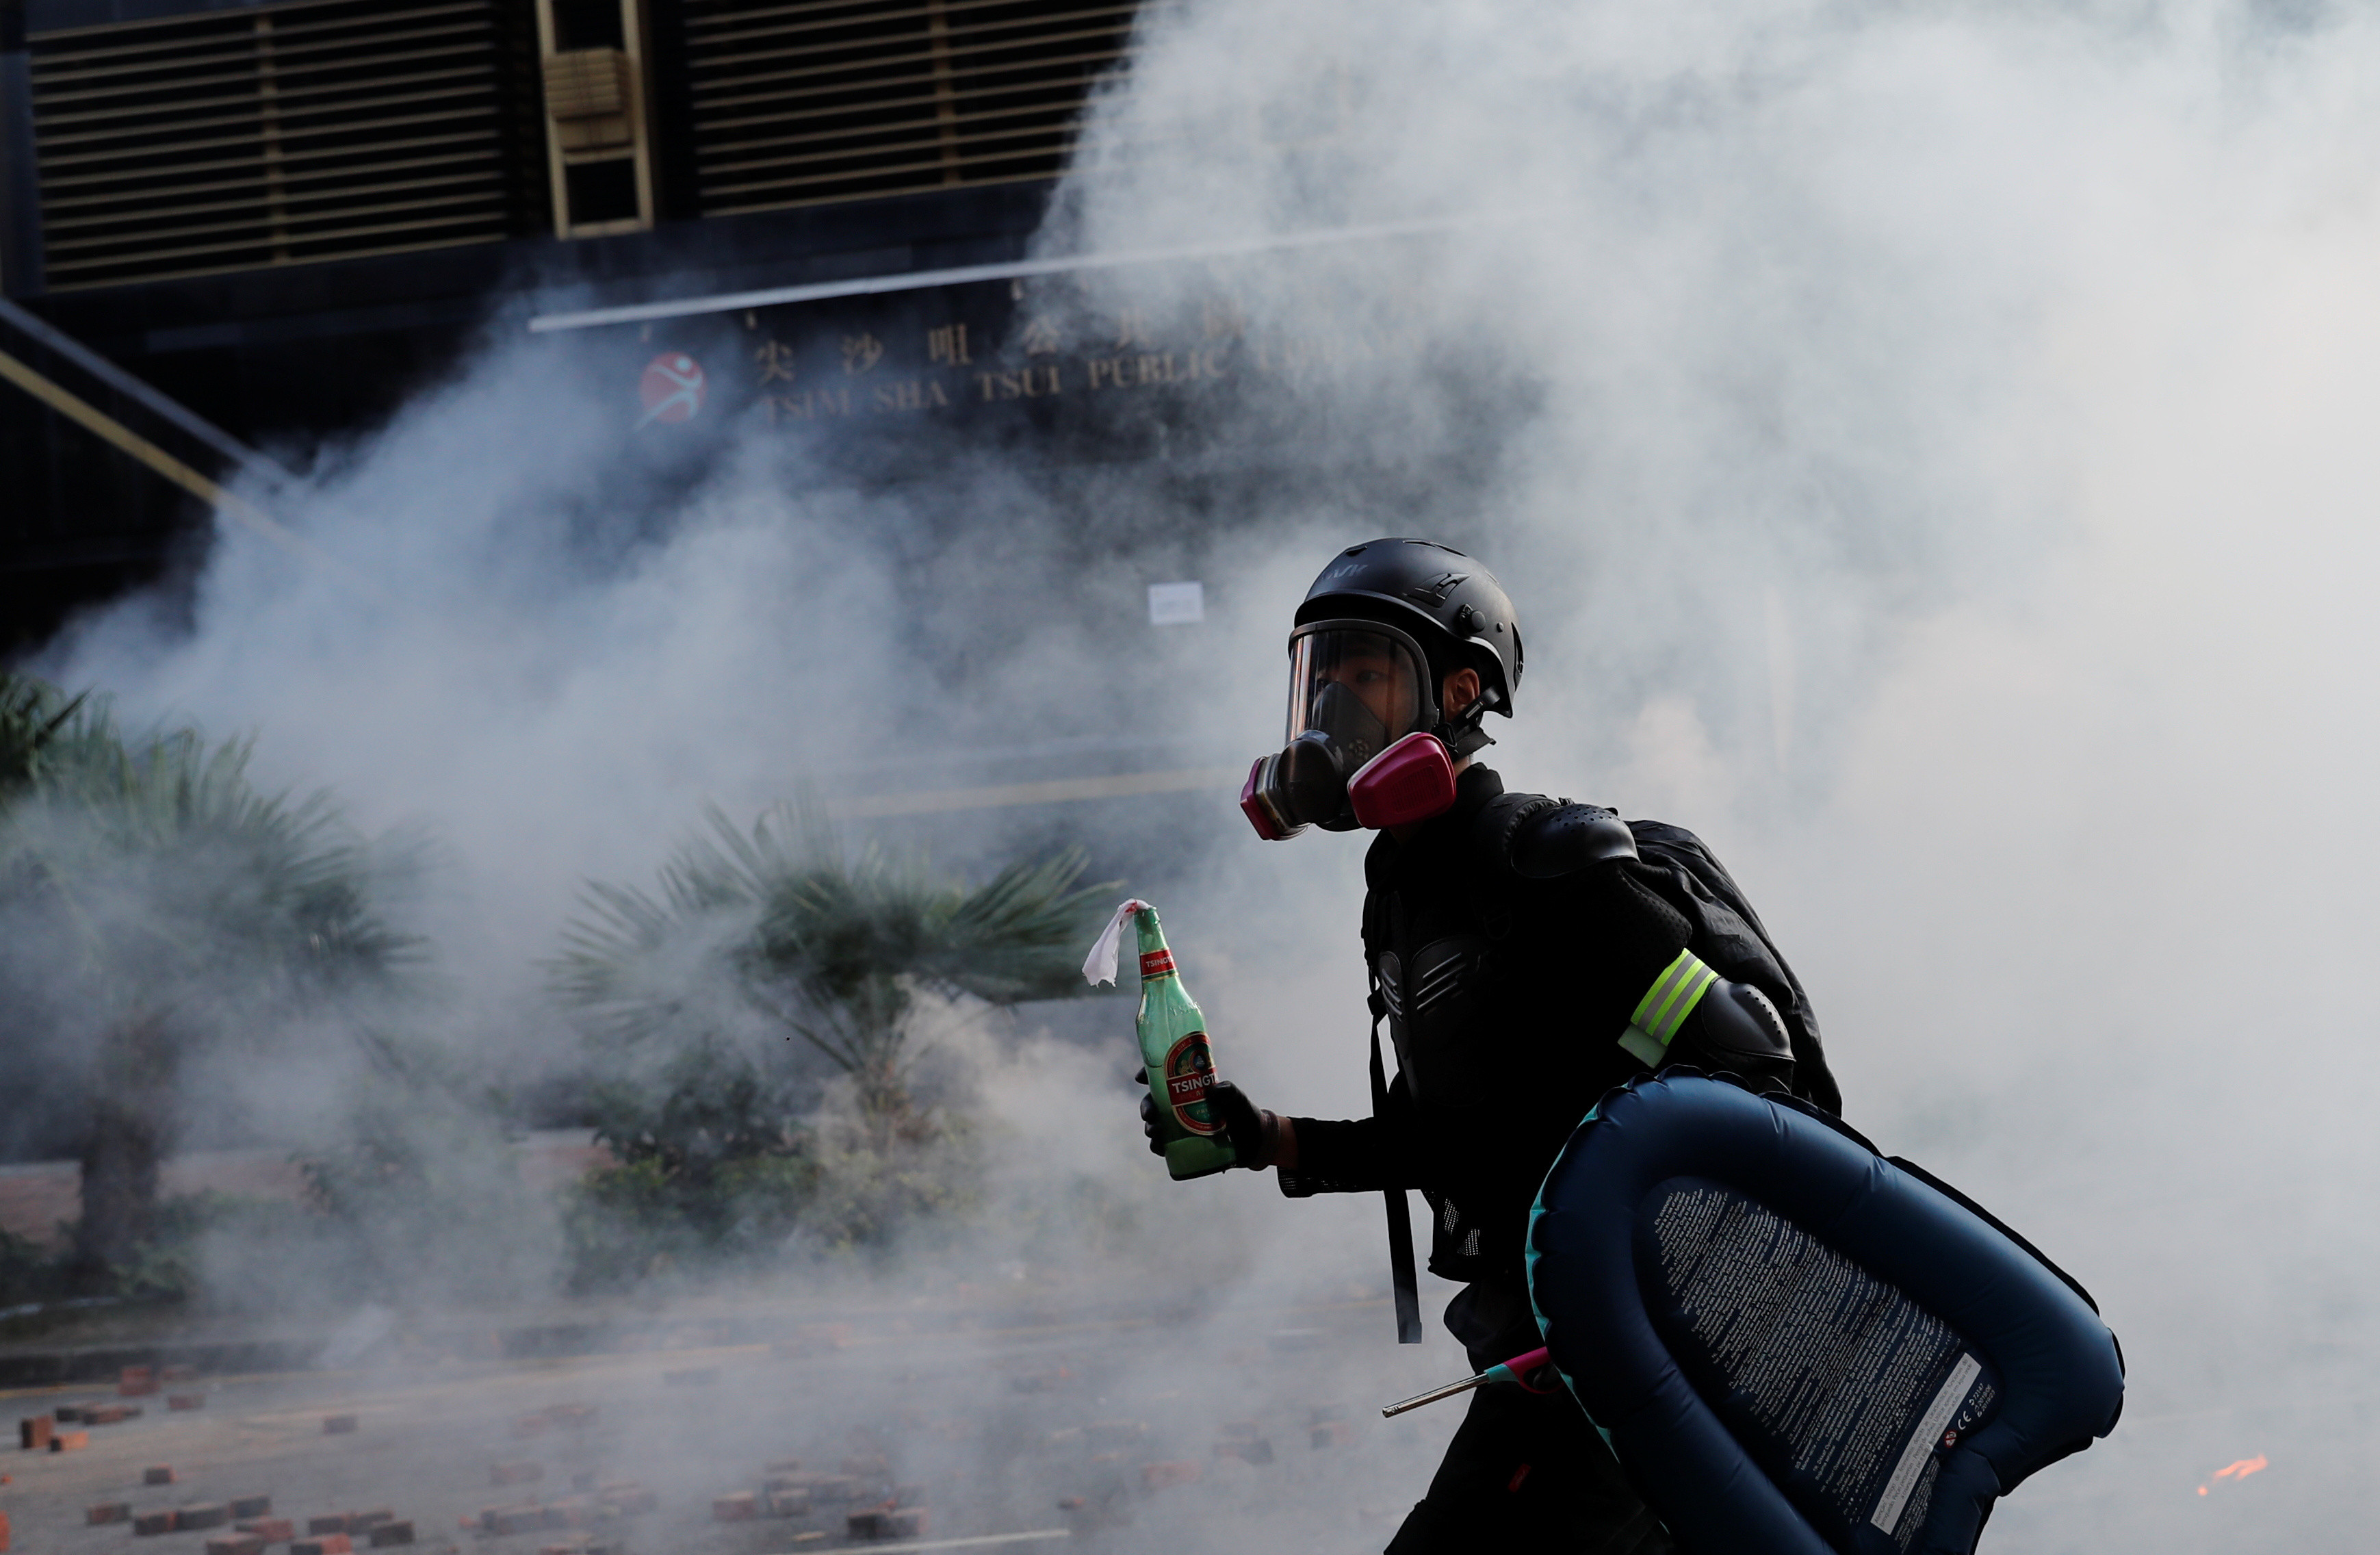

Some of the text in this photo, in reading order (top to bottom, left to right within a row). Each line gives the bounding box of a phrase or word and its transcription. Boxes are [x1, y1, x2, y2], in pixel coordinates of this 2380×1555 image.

[757, 389, 853, 424] TSIM
[871, 379, 949, 413] SHA
[972, 365, 1062, 402] TSUI
[1087, 345, 1229, 391] PUBLIC
[1146, 955, 1174, 968] TSINGT
[1172, 1073, 1218, 1094] TSINGT
